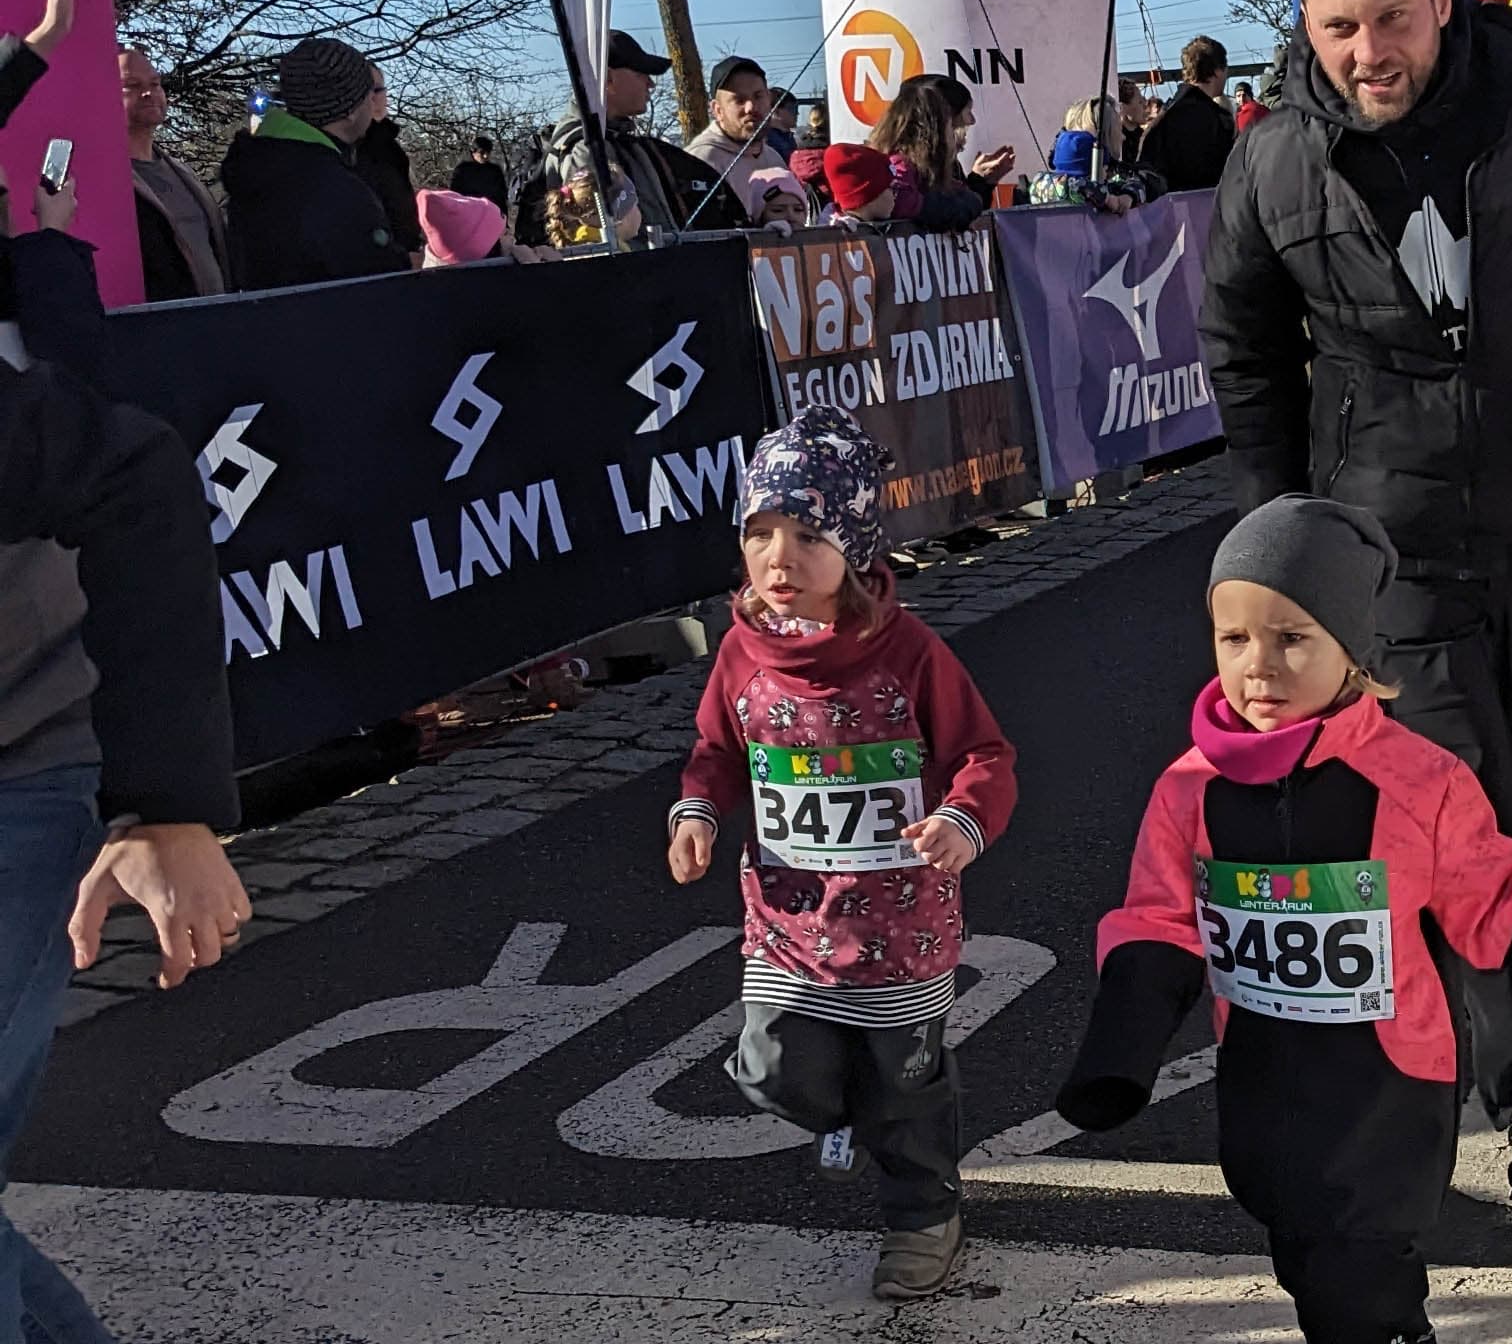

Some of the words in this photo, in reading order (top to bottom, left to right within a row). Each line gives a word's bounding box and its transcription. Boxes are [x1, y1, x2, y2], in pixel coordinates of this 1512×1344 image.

[944, 48, 1025, 86] NN
[753, 250, 873, 356] Náš
[887, 230, 993, 304] NOVINY
[786, 358, 885, 418] EGION
[890, 317, 1014, 401] ZDARMA
[607, 435, 747, 534] LAWI
[412, 479, 572, 600] LAWI
[220, 545, 363, 665] AWI
[758, 787, 909, 845] 3473
[1201, 906, 1374, 989] 3486
